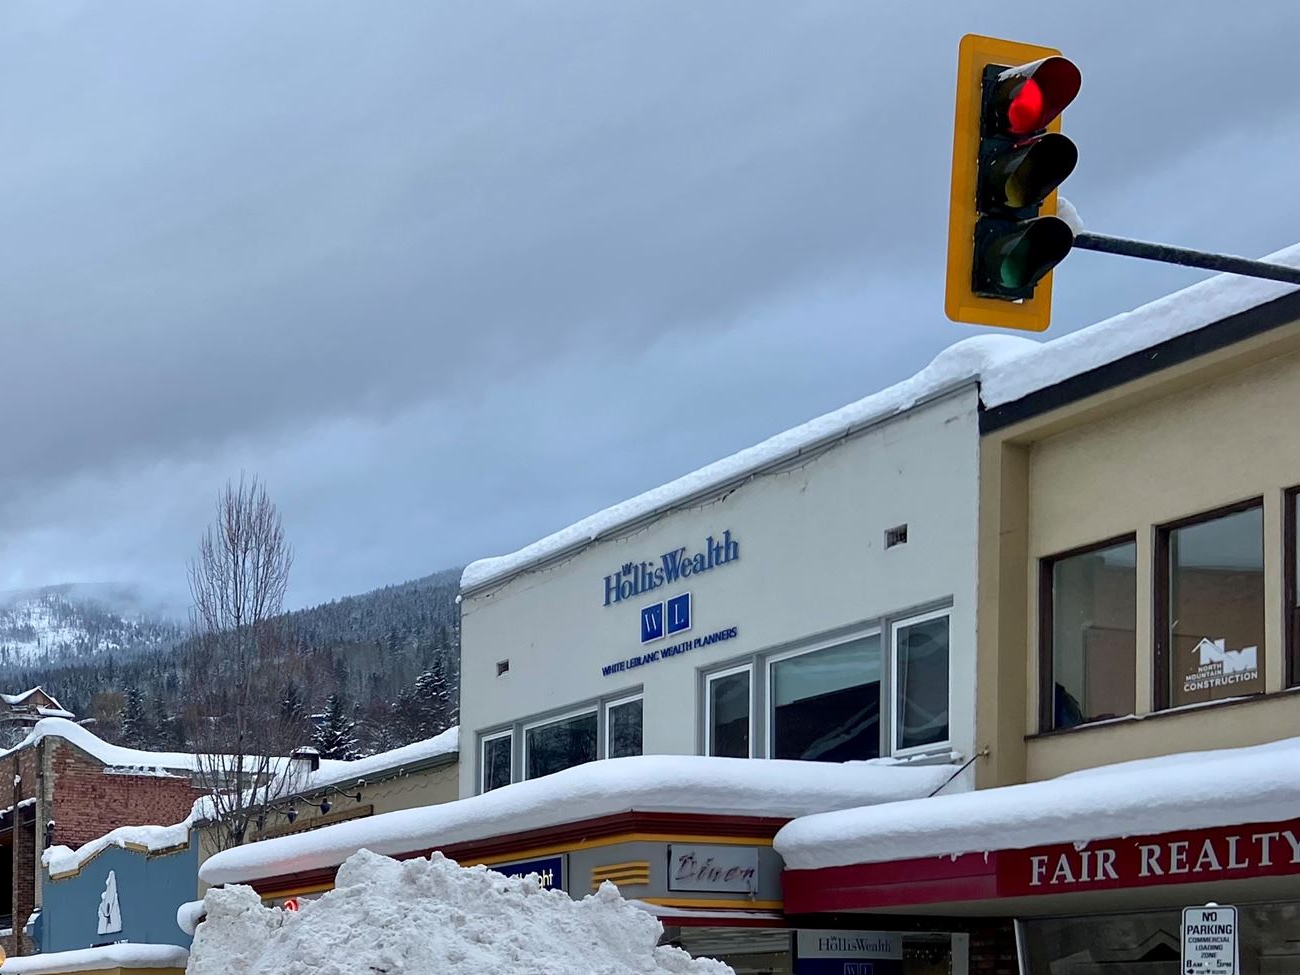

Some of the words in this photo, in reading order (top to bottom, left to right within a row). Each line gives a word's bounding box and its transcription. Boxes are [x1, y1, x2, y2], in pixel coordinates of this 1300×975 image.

[602, 529, 739, 607] HollisWealth
[602, 661, 625, 676] WHITE
[626, 650, 660, 669] LEBLANC
[660, 640, 693, 659] WEALTH
[694, 626, 737, 648] PLANNERS
[1185, 670, 1222, 682] MOUNTAIN
[1198, 663, 1222, 673] NORTH
[1183, 671, 1258, 692] CONSTRUCTION
[1029, 848, 1119, 886] FAIR
[1138, 830, 1300, 877] REALTY
[1202, 911, 1217, 922] NO
[1186, 924, 1233, 935] PARKING
[818, 936, 891, 952] HollisWealth
